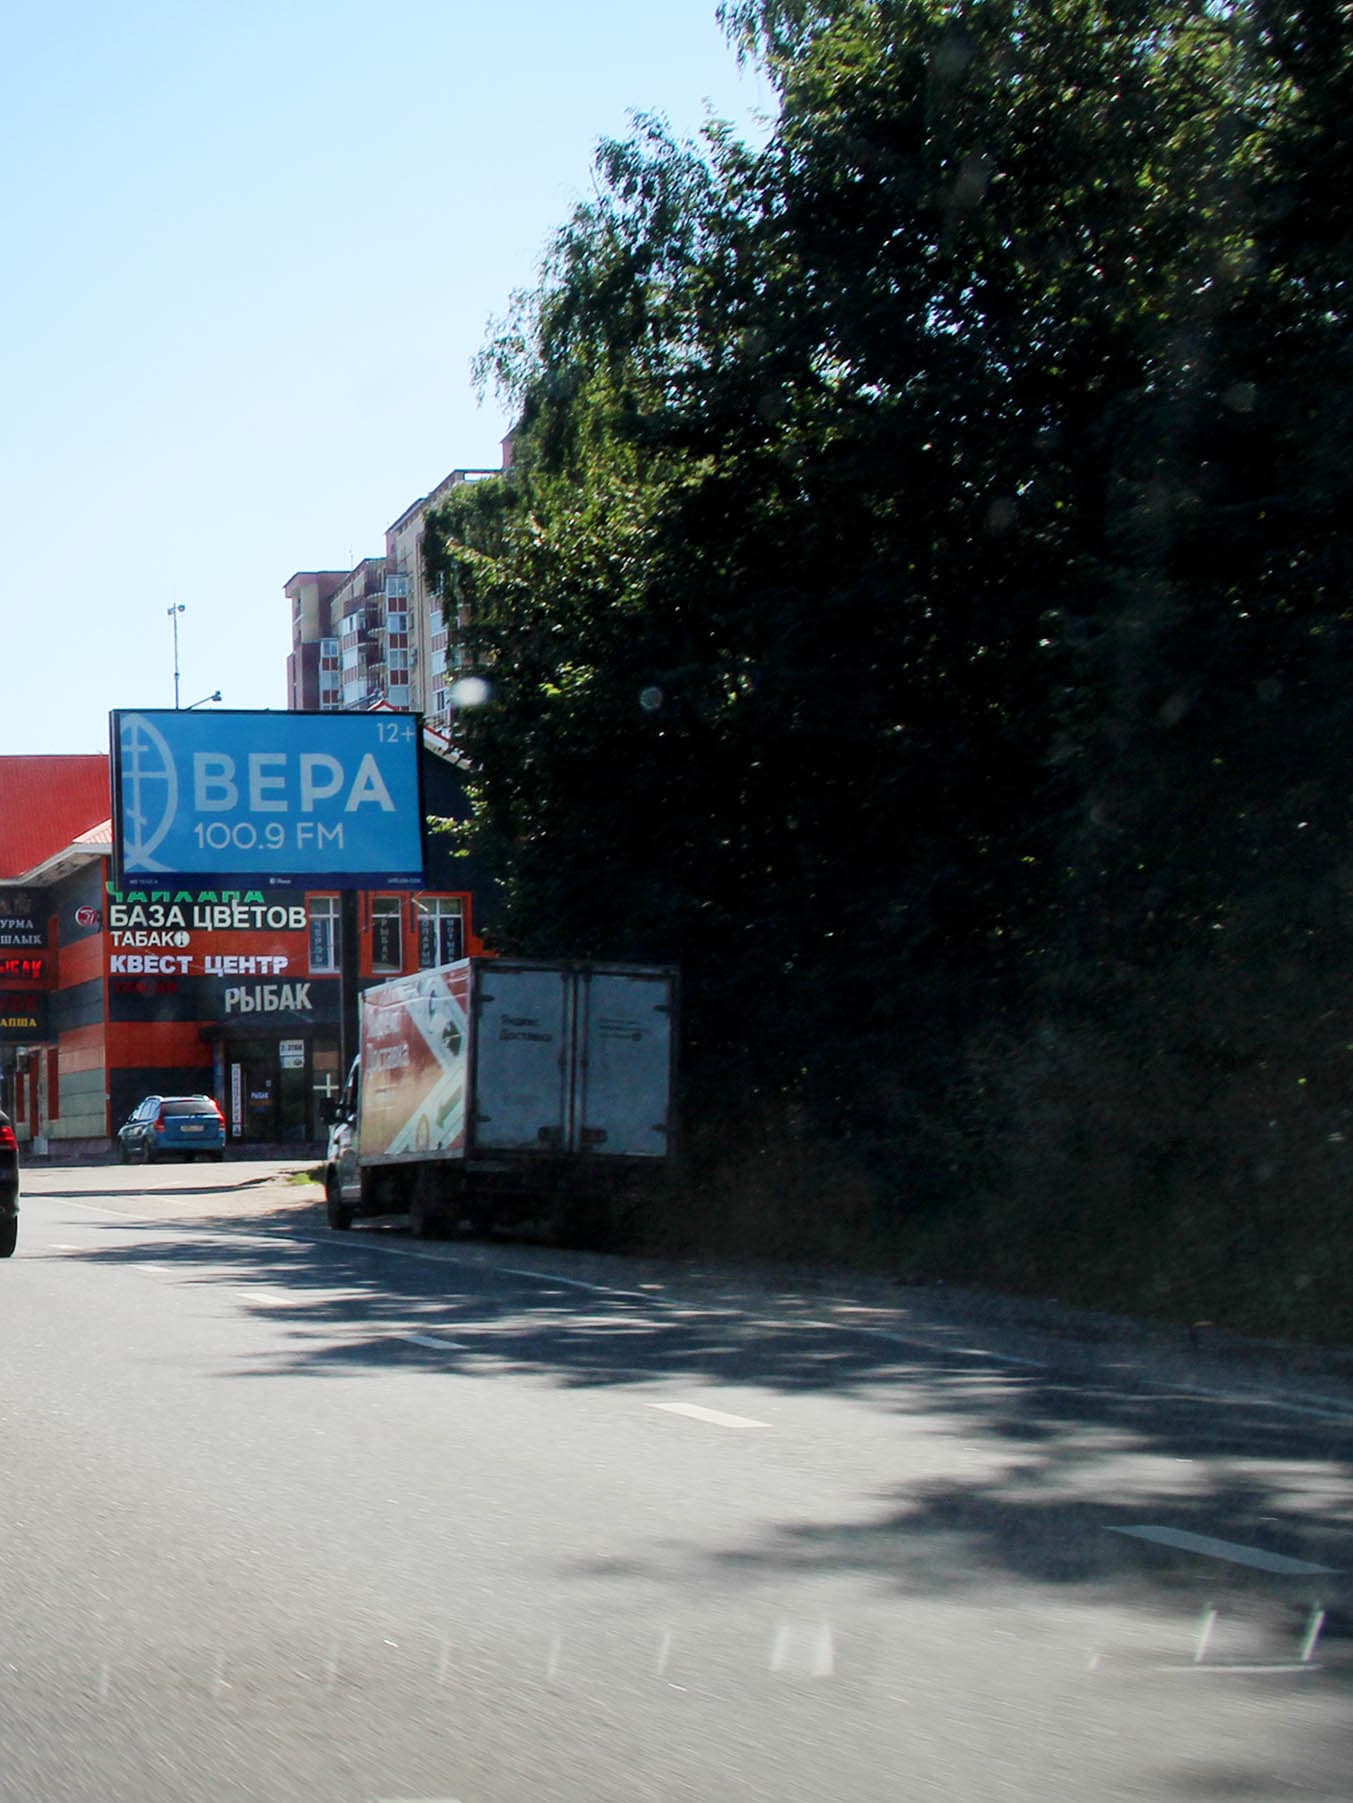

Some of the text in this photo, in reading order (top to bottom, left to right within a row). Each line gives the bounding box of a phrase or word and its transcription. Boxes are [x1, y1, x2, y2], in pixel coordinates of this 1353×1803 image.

[376, 722, 415, 743] 12+
[193, 752, 396, 813] ВЕРА
[194, 822, 345, 849] 100.9 FM
[109, 905, 307, 932] БАЗА ЦВЕТОВ
[110, 955, 289, 977] КВЕСТ ЦЕНТР
[225, 983, 313, 1013] РЫБАК
